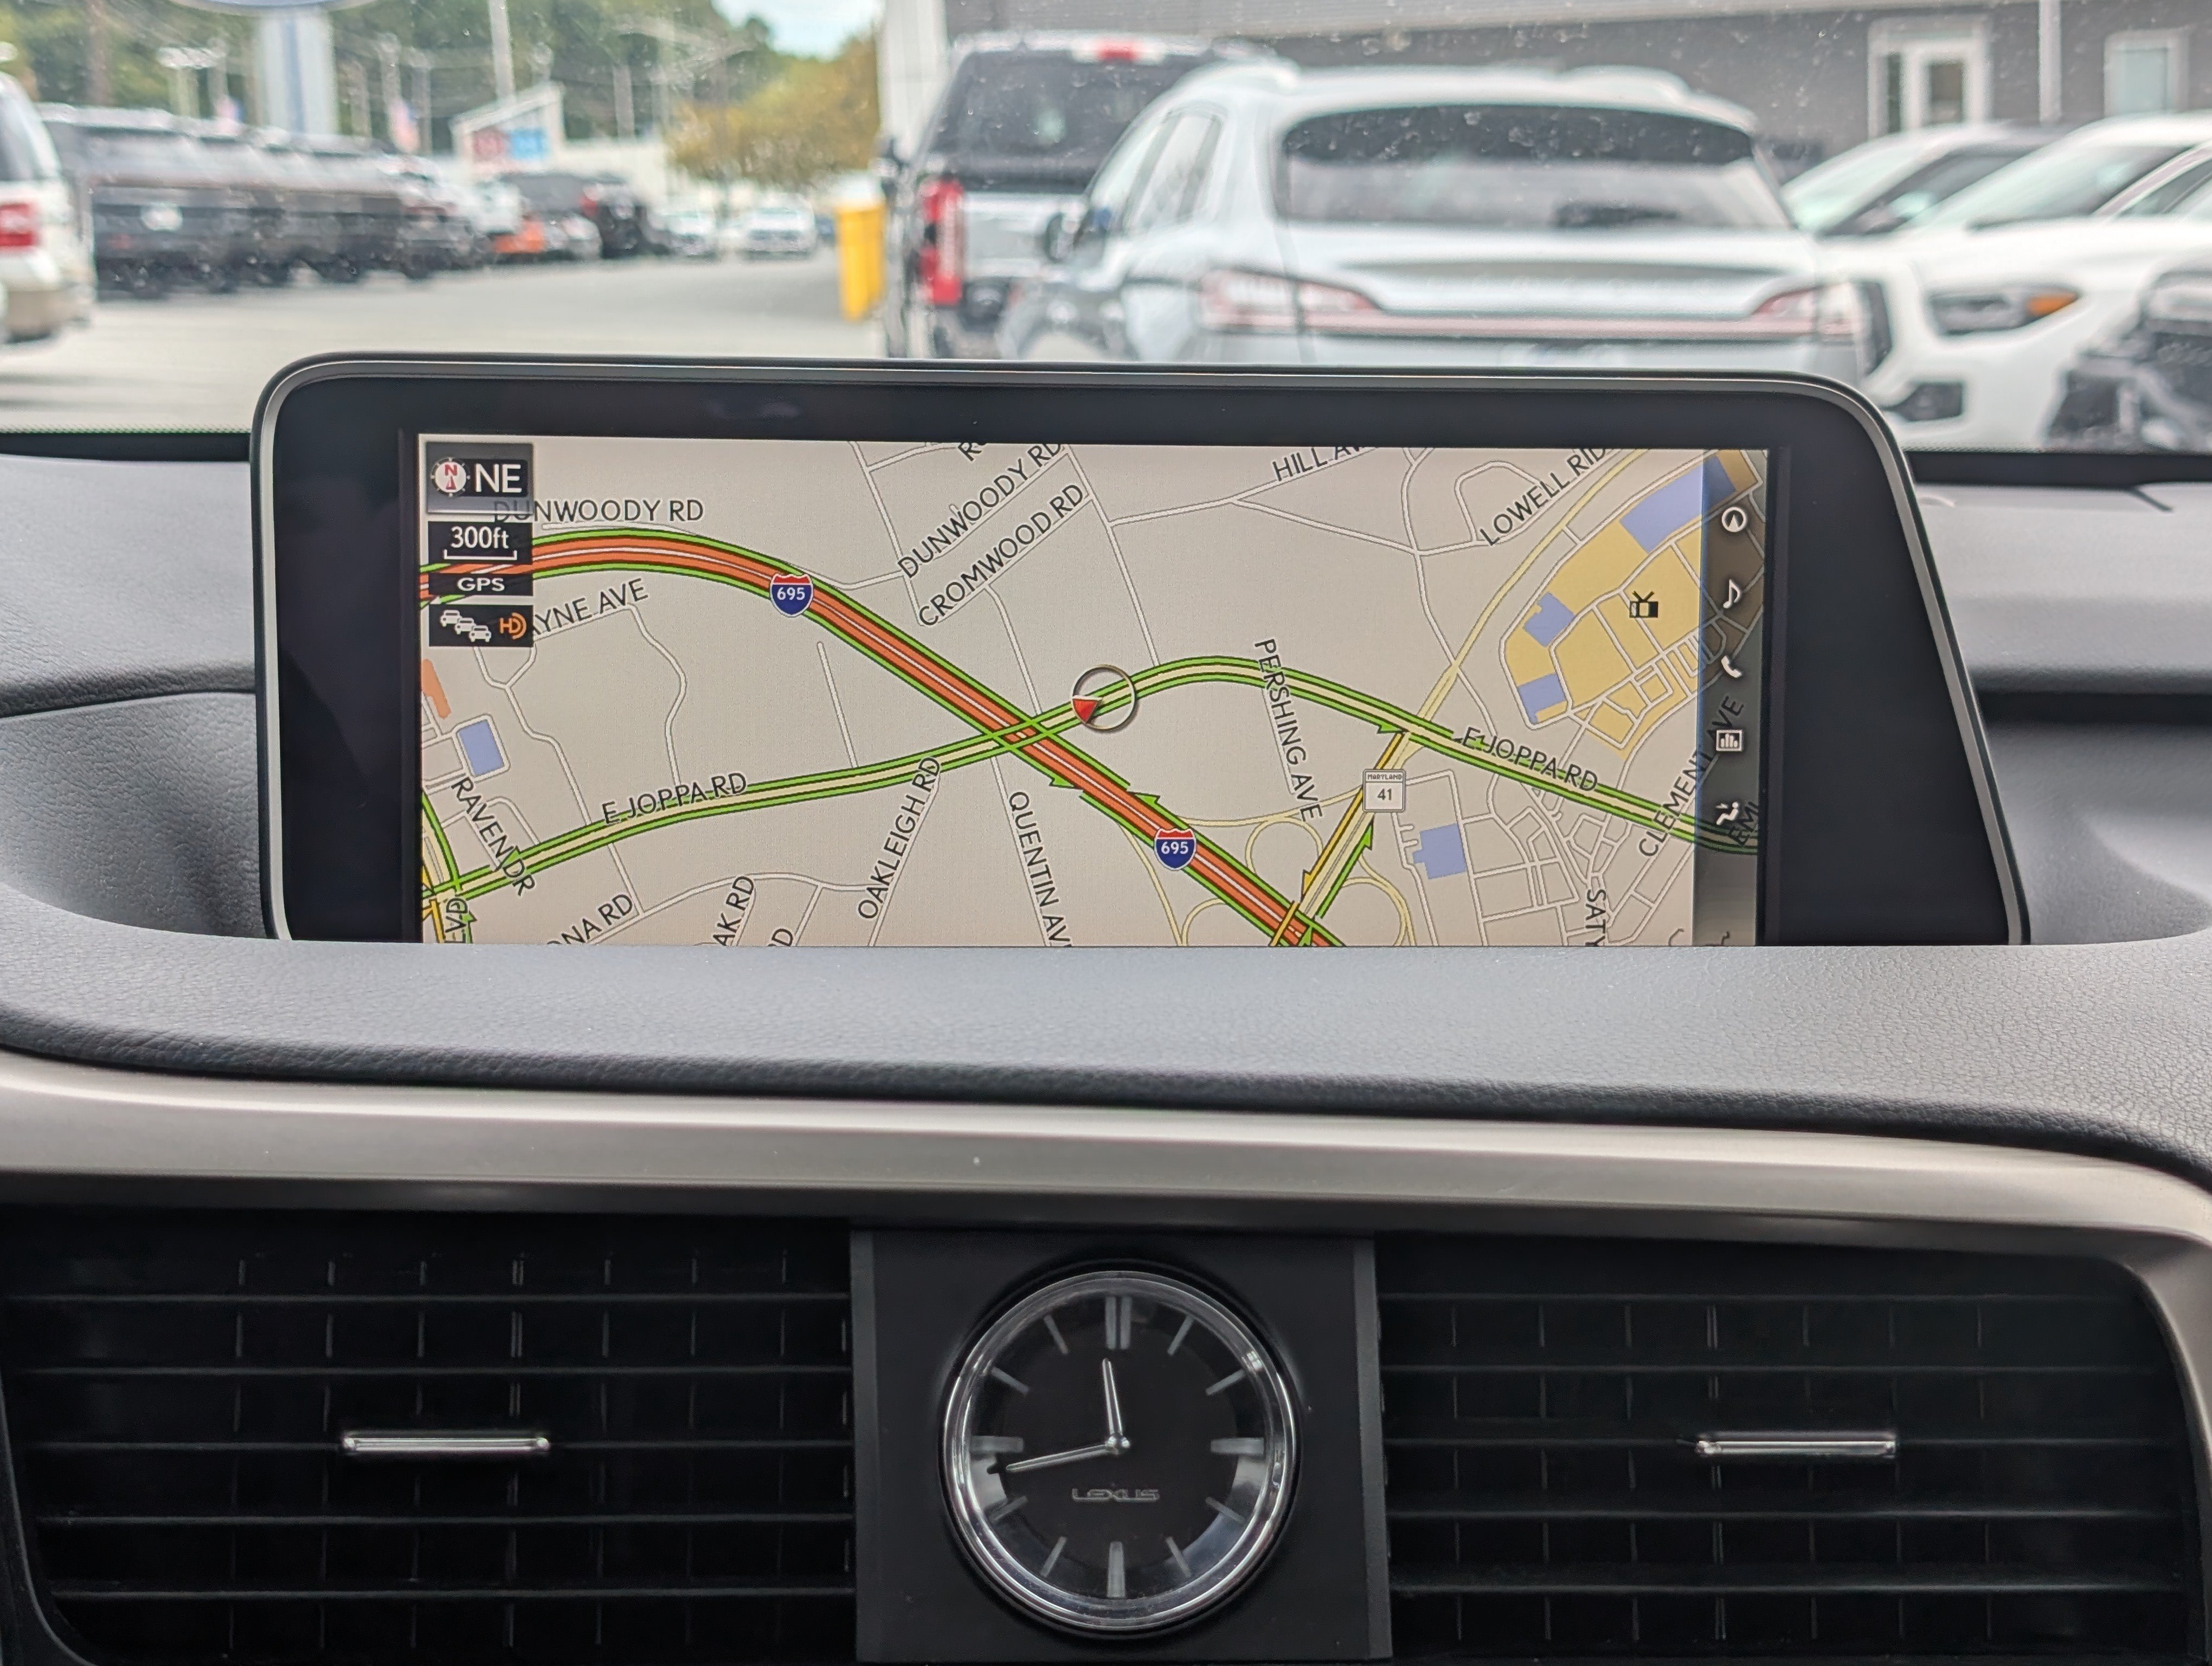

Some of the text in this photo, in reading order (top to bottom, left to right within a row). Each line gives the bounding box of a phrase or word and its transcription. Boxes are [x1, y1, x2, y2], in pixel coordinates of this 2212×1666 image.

[958, 442, 986, 462] R
[1272, 447, 1328, 481] HILL
[444, 464, 458, 476] N
[475, 463, 523, 493] NE
[494, 499, 704, 522] DUNWOODY RD
[897, 443, 1062, 579] DUNWOODY RD
[1480, 472, 1570, 546] LOWELL
[451, 526, 509, 549] 300ft
[919, 484, 1083, 626] CROMWOOD RD
[457, 578, 505, 592] GPS
[600, 578, 648, 614] AVE
[777, 587, 806, 600] 695
[1255, 638, 1323, 822] PERSHING AVE
[1462, 726, 1598, 792] E JOPPA RD
[602, 773, 747, 824] E JOPPA RD
[1377, 788, 1392, 800] 41
[1638, 744, 1714, 857] CLEMENT
[451, 777, 536, 896] RAVEN DR
[858, 757, 940, 919] OAKLEIGH RD
[1161, 841, 1189, 854] 695
[1009, 791, 1072, 947] QUENTIN AV
[597, 894, 633, 926] RD
[725, 876, 754, 911] RD
[767, 928, 794, 947] D
[1071, 1488, 1161, 1502] LEXUS
